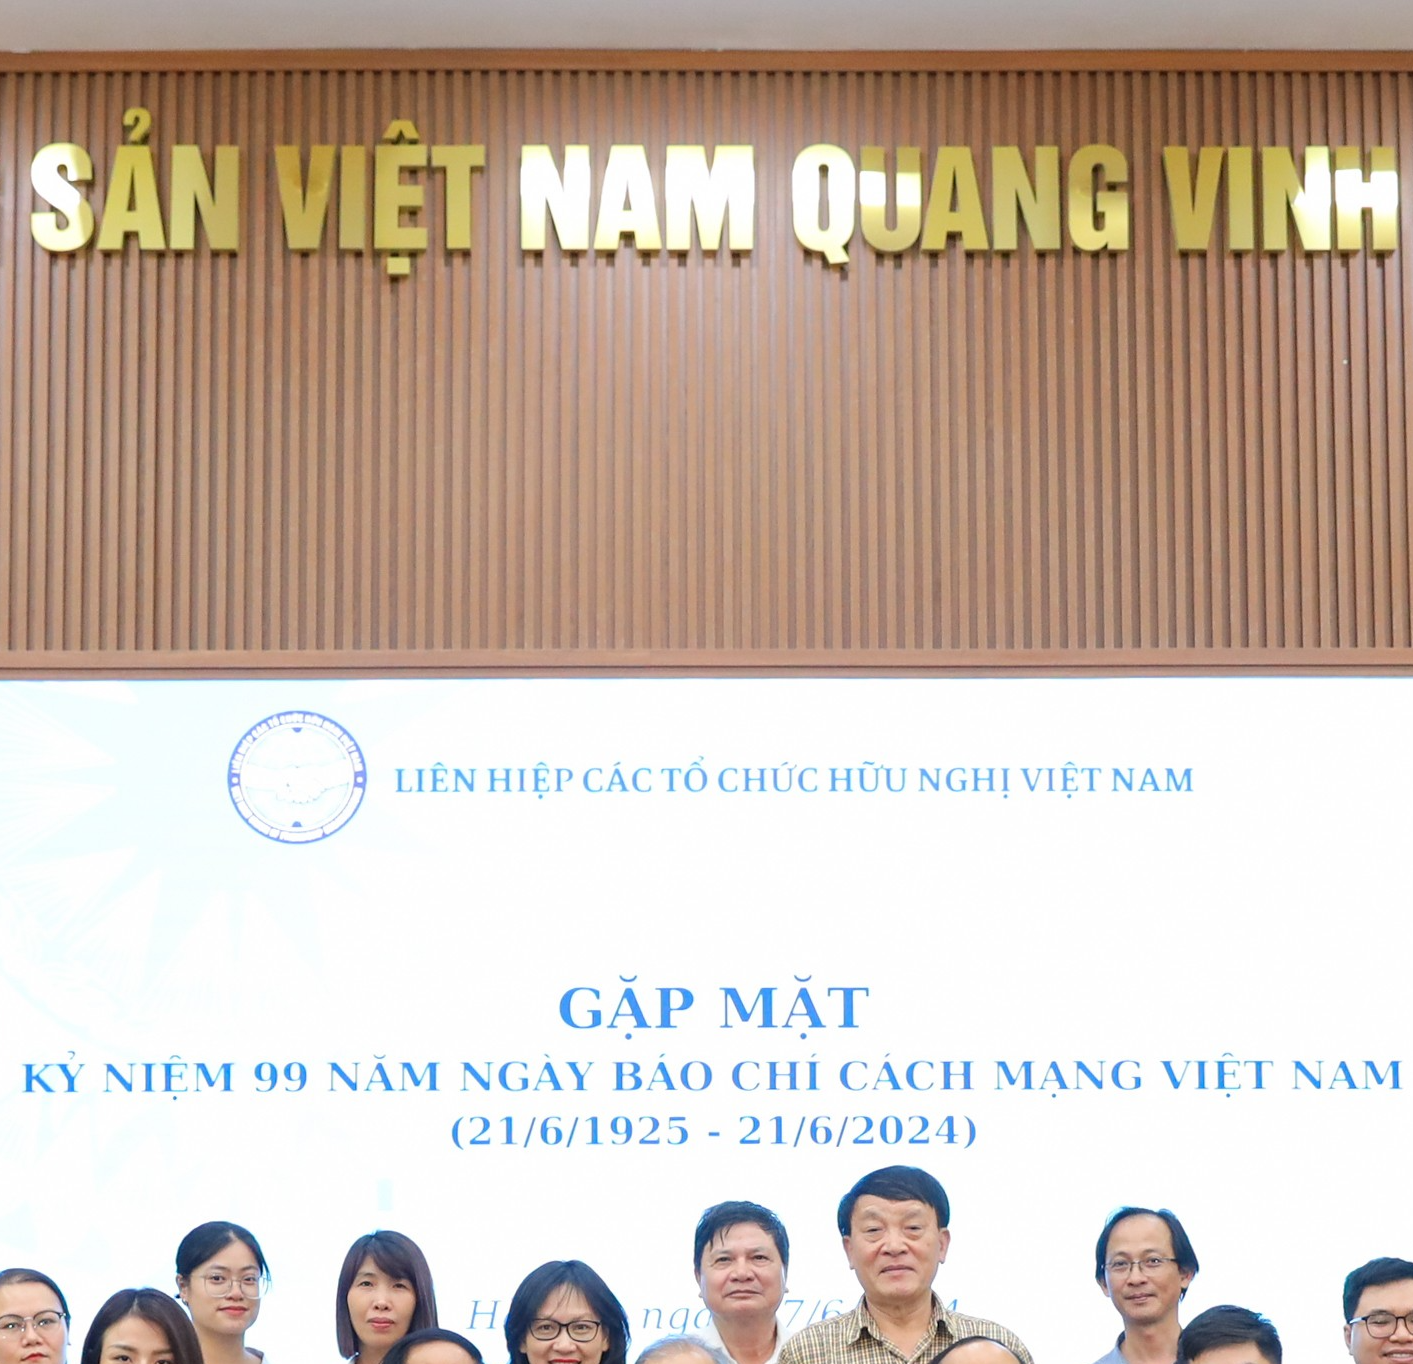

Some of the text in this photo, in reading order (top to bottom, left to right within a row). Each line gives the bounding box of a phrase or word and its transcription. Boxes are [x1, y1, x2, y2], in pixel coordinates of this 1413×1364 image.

[30, 107, 241, 254] SẢN
[275, 119, 485, 276] VIỆT
[519, 143, 756, 255] NAM
[792, 142, 1129, 268] QUANG
[1163, 144, 1398, 255] VINH
[395, 756, 1193, 800] LIÊN HIỆP CÁC TỔ CHỨC HỮU NGHỊ VIỆT NAM
[558, 975, 870, 1041] GẶP MẶT
[23, 1051, 1403, 1100] KỶ NIỆM 99 NĂM NGÀY BÁO CHÍ CÁCH MẠNG VIỆT NAM
[451, 1115, 689, 1150] (21/6/1925
[739, 1114, 977, 1149] 21/6/2024)
